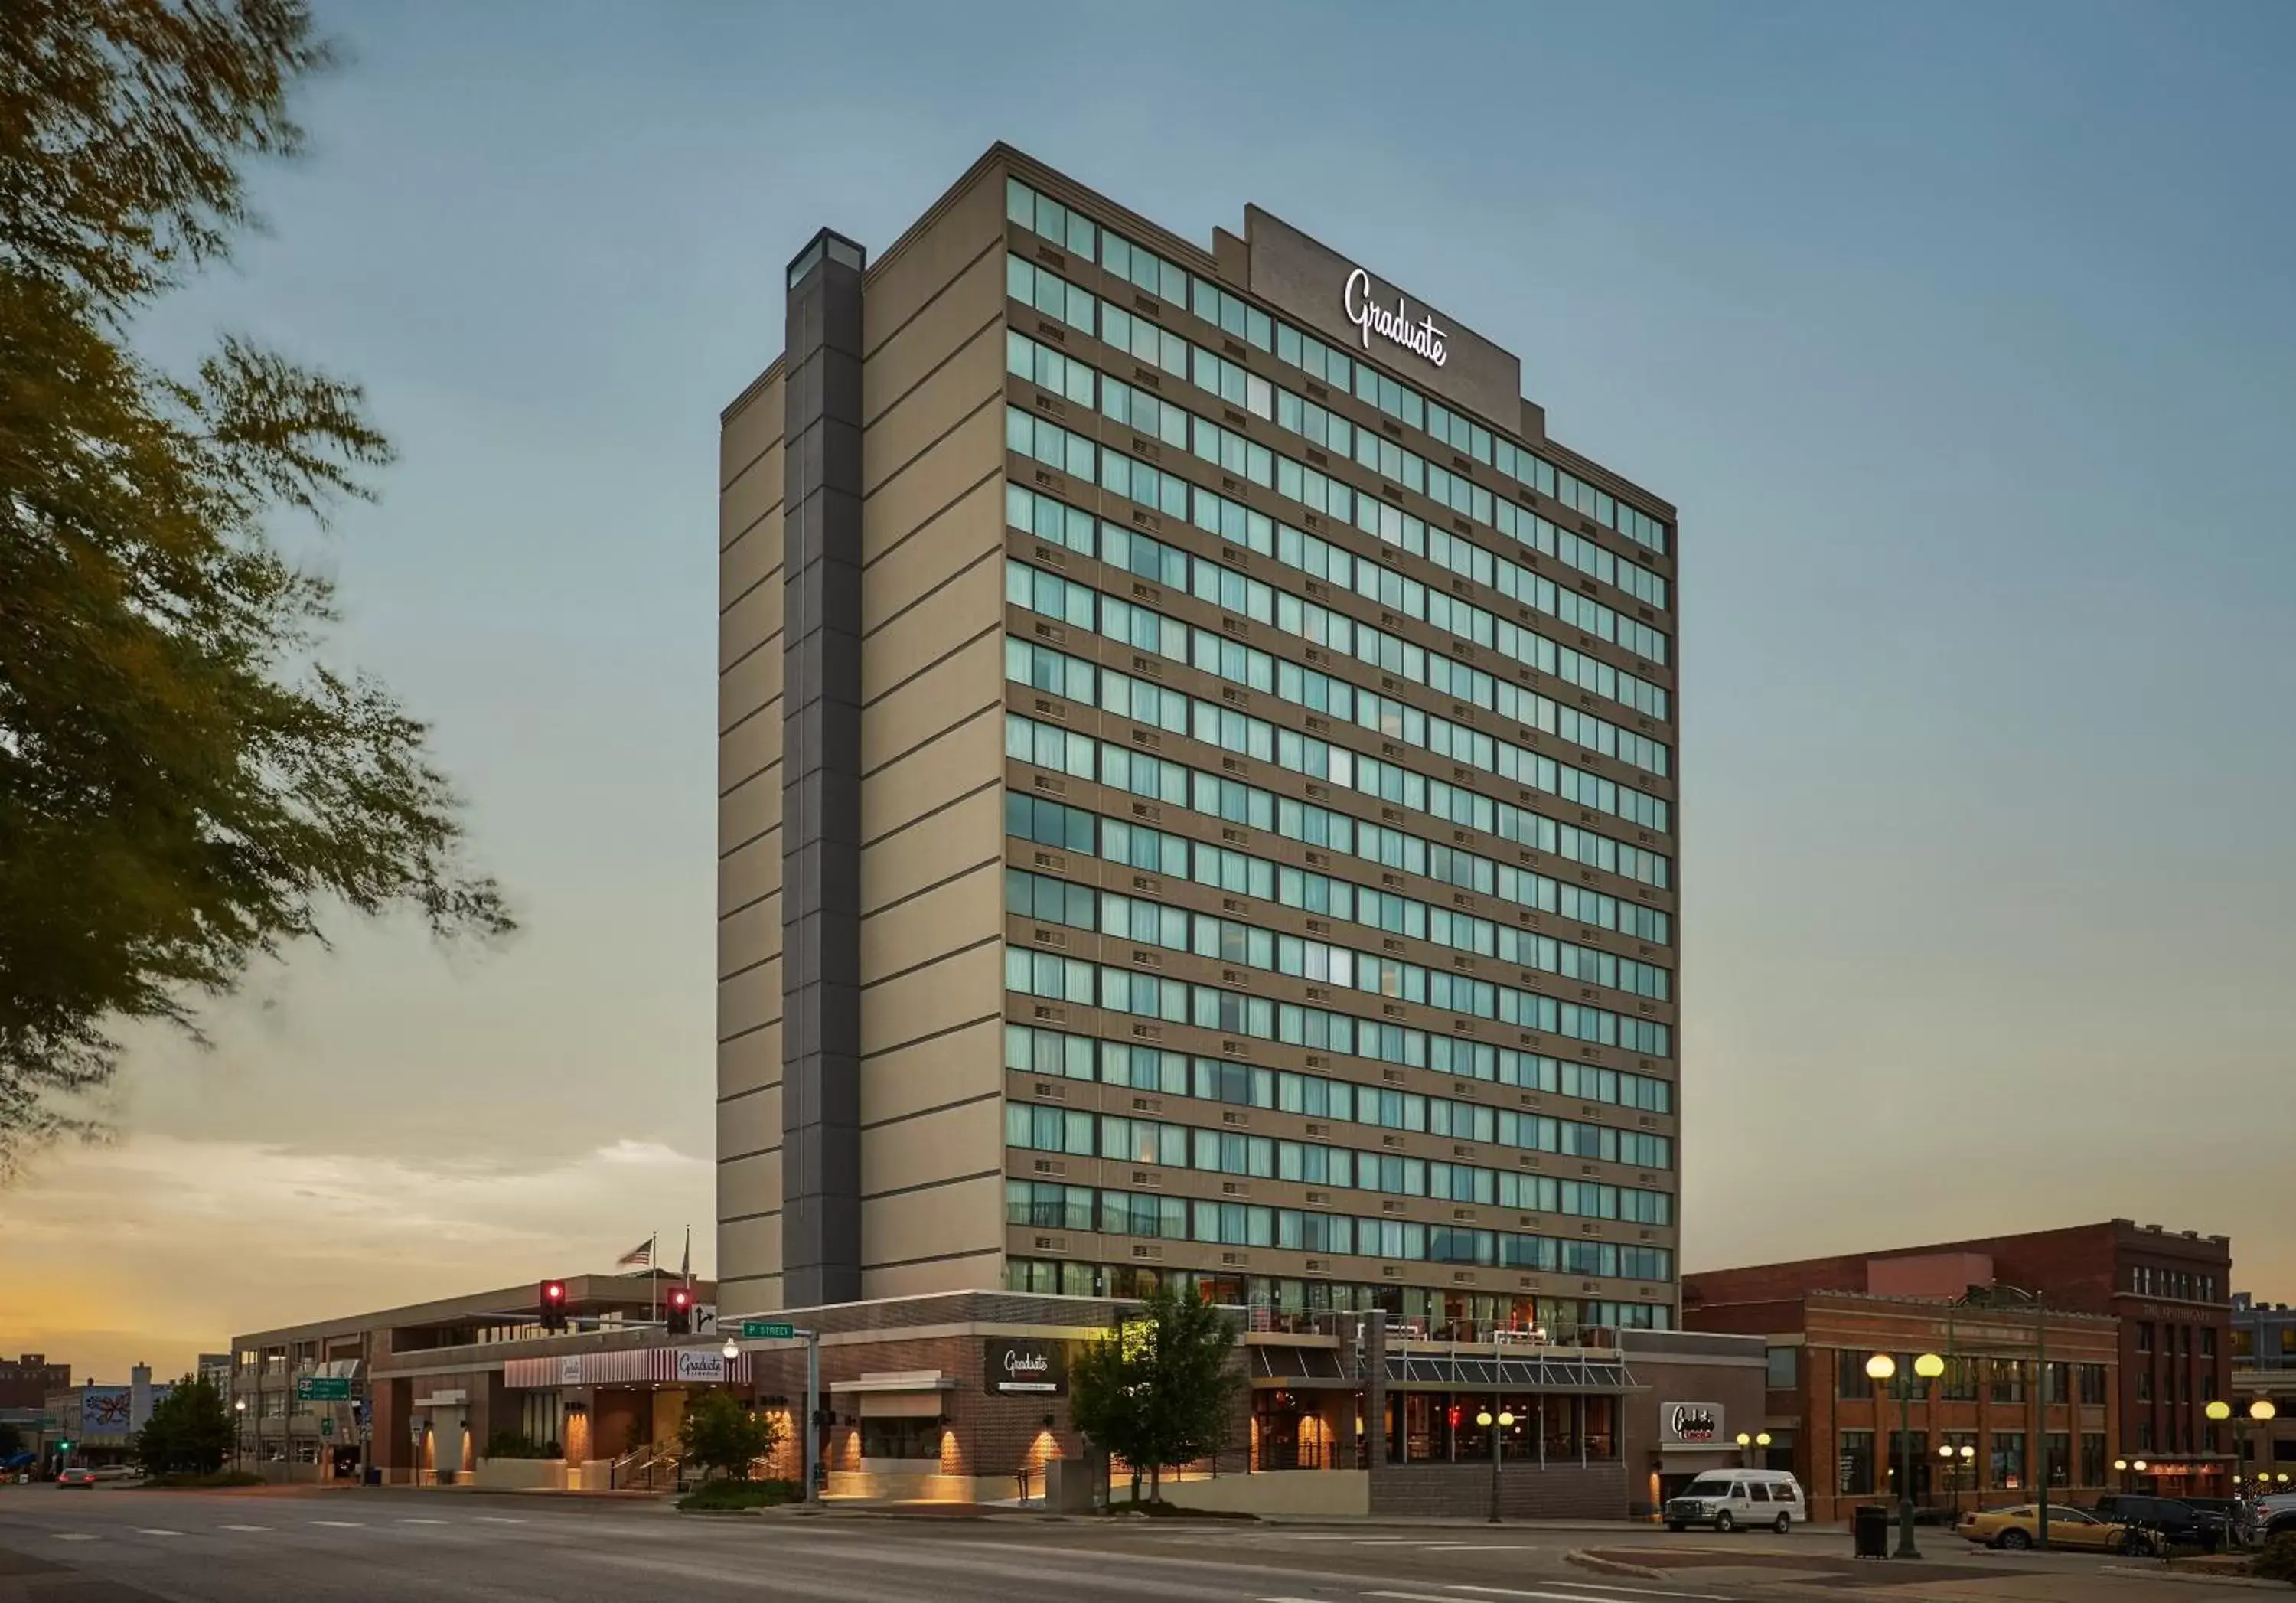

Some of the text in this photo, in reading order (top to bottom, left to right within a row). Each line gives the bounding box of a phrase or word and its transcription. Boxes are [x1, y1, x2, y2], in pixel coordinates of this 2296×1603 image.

[1345, 269, 1448, 367] Graduate
[749, 1326, 788, 1336] P STREET
[679, 1353, 722, 1376] Graduate
[1004, 1350, 1048, 1379] Graduate
